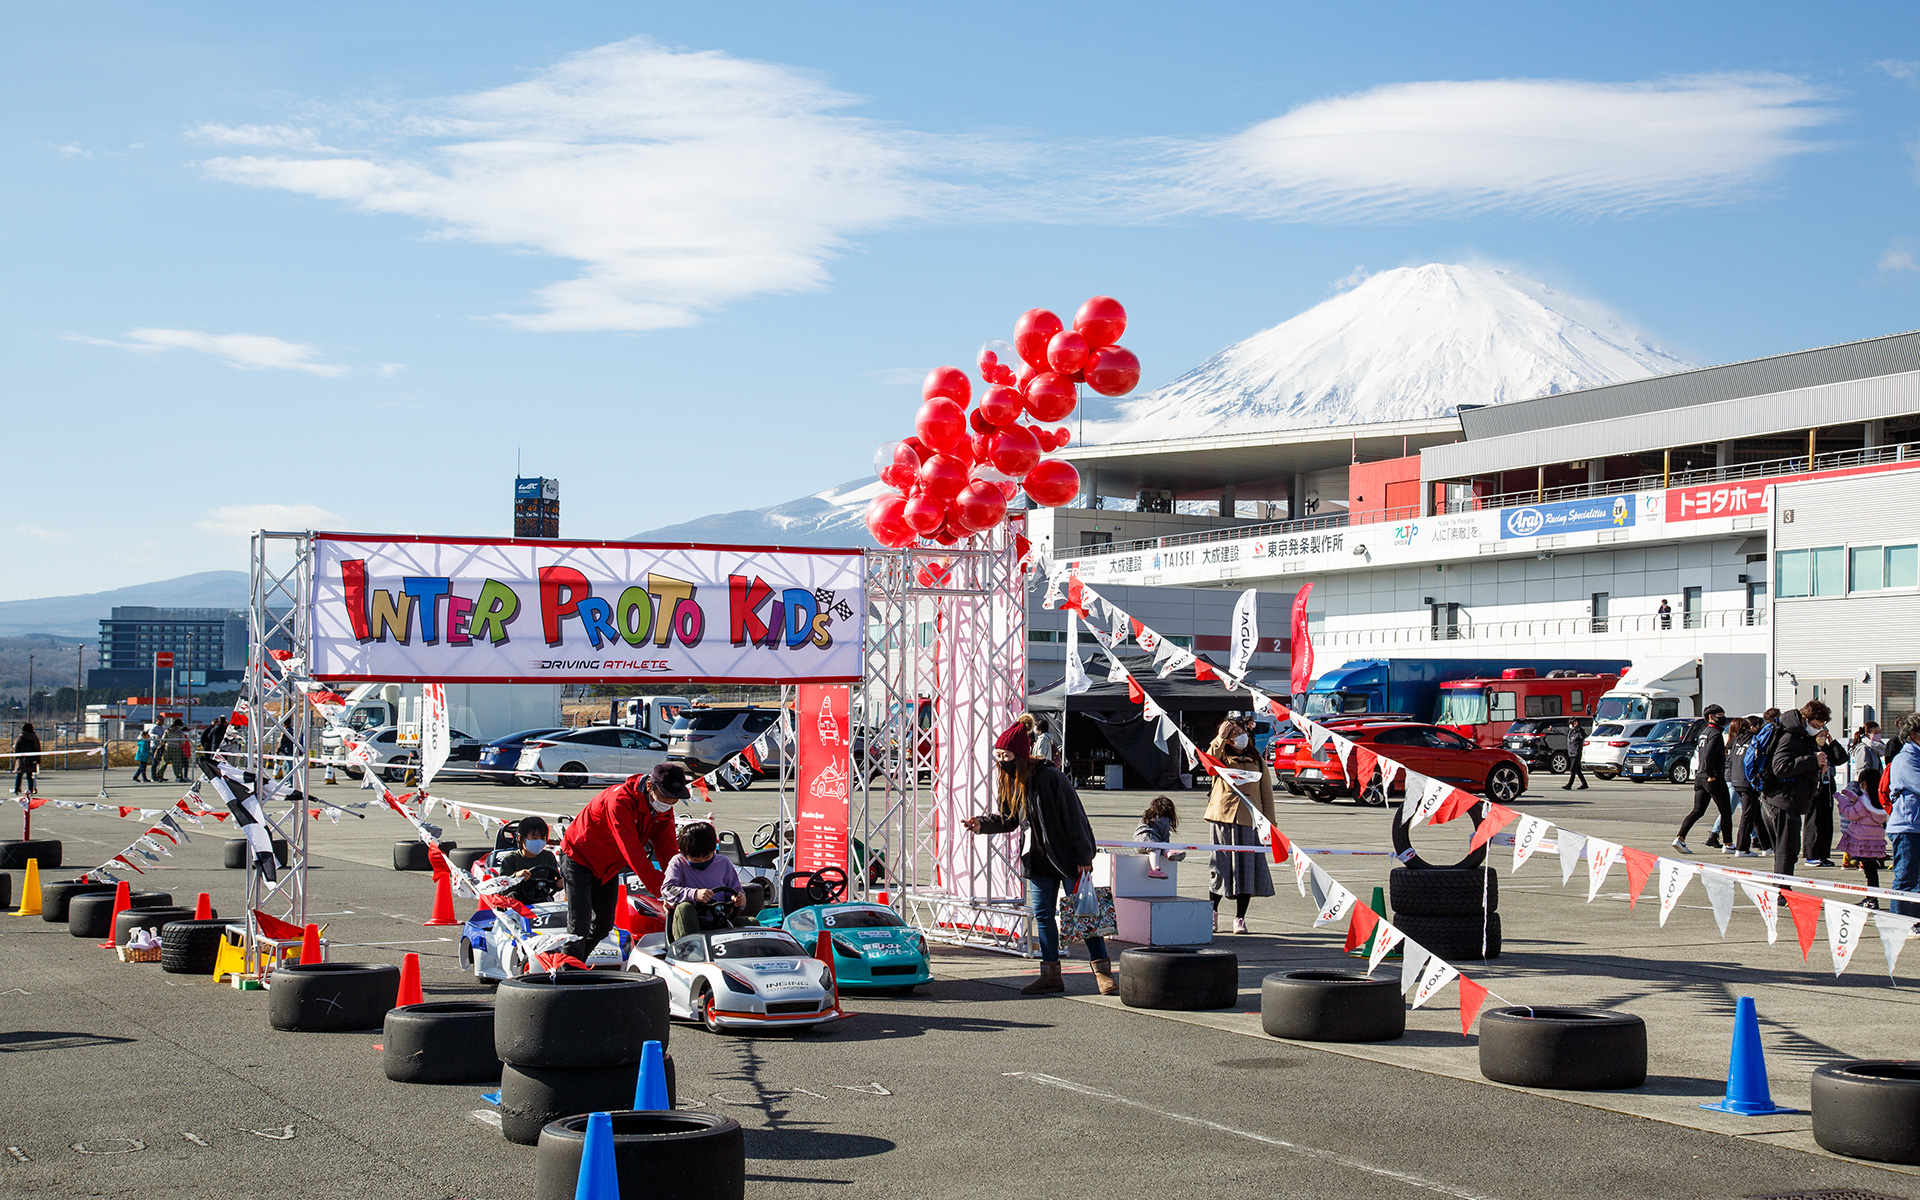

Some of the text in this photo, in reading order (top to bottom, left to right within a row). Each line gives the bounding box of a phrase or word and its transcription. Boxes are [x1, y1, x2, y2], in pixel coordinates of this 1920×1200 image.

[1545, 512, 1567, 525] Racing
[1568, 508, 1607, 522] Specialities
[1785, 511, 1792, 523] 3
[1267, 533, 1344, 558] 東京発条製作所
[1163, 550, 1195, 567] TAISEI
[1202, 546, 1239, 565] 大成建設
[1109, 556, 1142, 574] 大成建設
[1238, 608, 1250, 670] JAGUAR
[1273, 640, 1281, 651] 2
[540, 660, 668, 669] DRIVING ATHLETE
[630, 881, 646, 891] 55
[532, 914, 552, 927] 37
[825, 915, 836, 926] 8
[714, 944, 727, 957] 3
[765, 980, 809, 989] INGING
